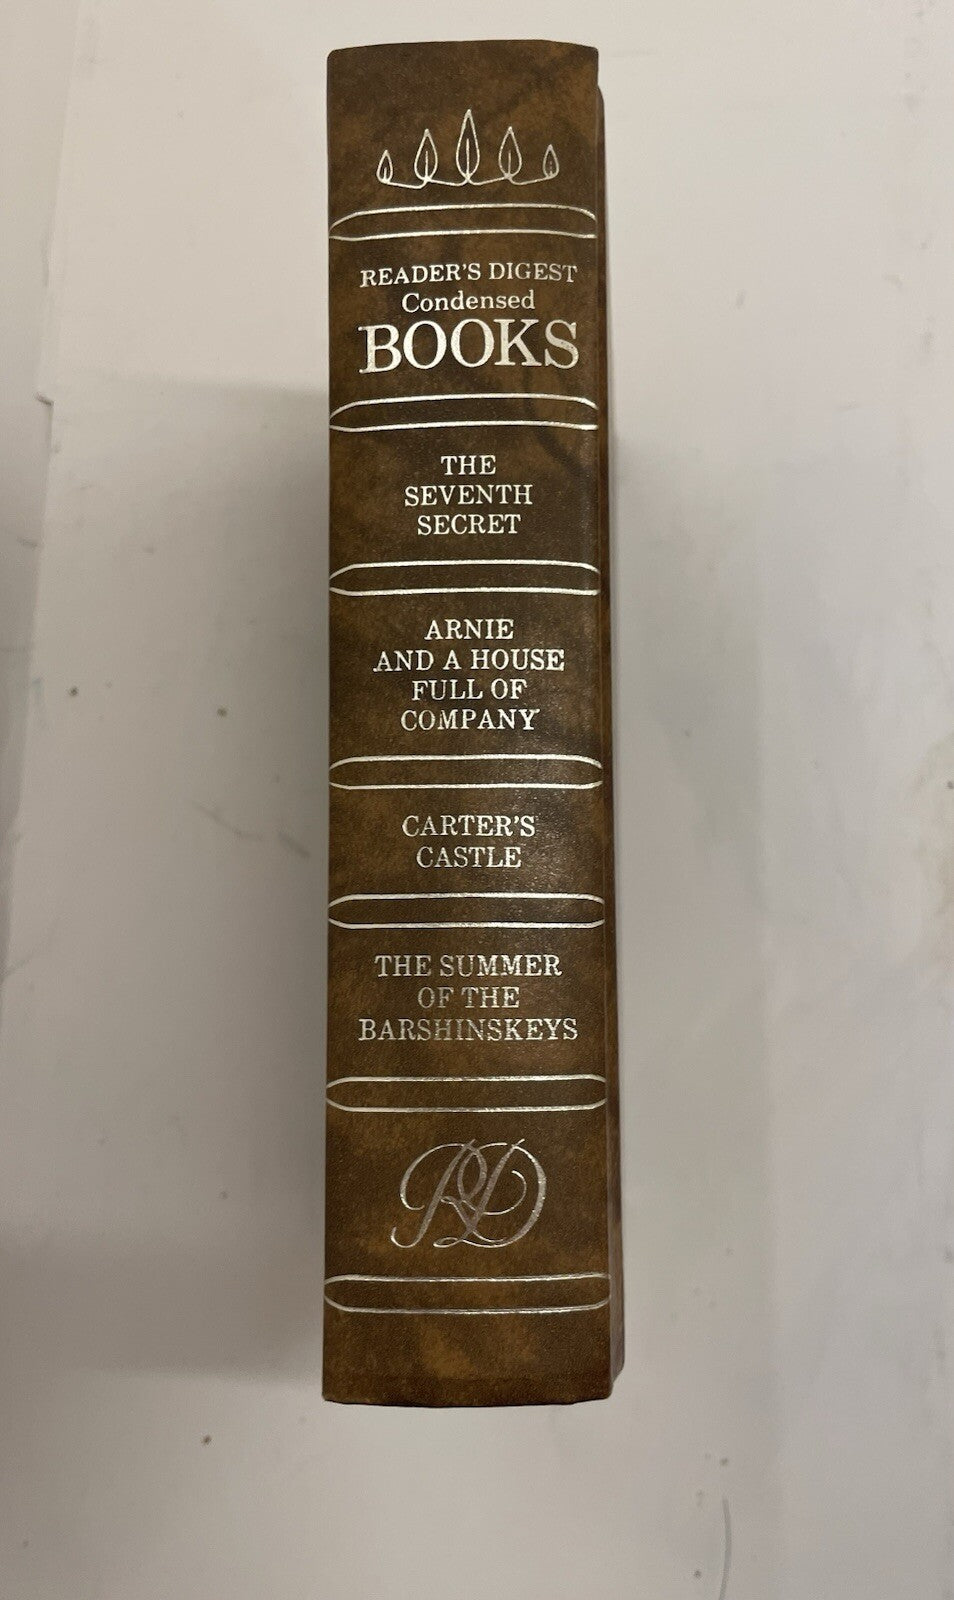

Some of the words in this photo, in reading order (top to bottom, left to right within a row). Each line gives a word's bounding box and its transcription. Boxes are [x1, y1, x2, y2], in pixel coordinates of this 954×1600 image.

[359, 263, 482, 288] READER'S
[489, 262, 579, 283] DIGEST
[402, 290, 536, 313] Condensed
[358, 319, 580, 375] BOOKS
[440, 455, 497, 476] THE
[404, 483, 534, 507] SEVENTH
[417, 513, 521, 536] SECRET
[424, 618, 515, 641] ARNIE
[373, 649, 434, 672] AND
[442, 649, 462, 671] A
[471, 648, 566, 672] HOUSE
[411, 679, 483, 701] FULL
[491, 678, 528, 701] OF
[400, 708, 541, 732] COMPANY
[402, 814, 536, 838] CARTER'S
[416, 846, 522, 869] CASTLE
[374, 954, 432, 978] THE
[440, 954, 563, 978] SUMMER
[417, 987, 455, 1010] OF
[462, 986, 520, 1009] THE
[358, 1017, 579, 1042] BARSHINSKEYS
